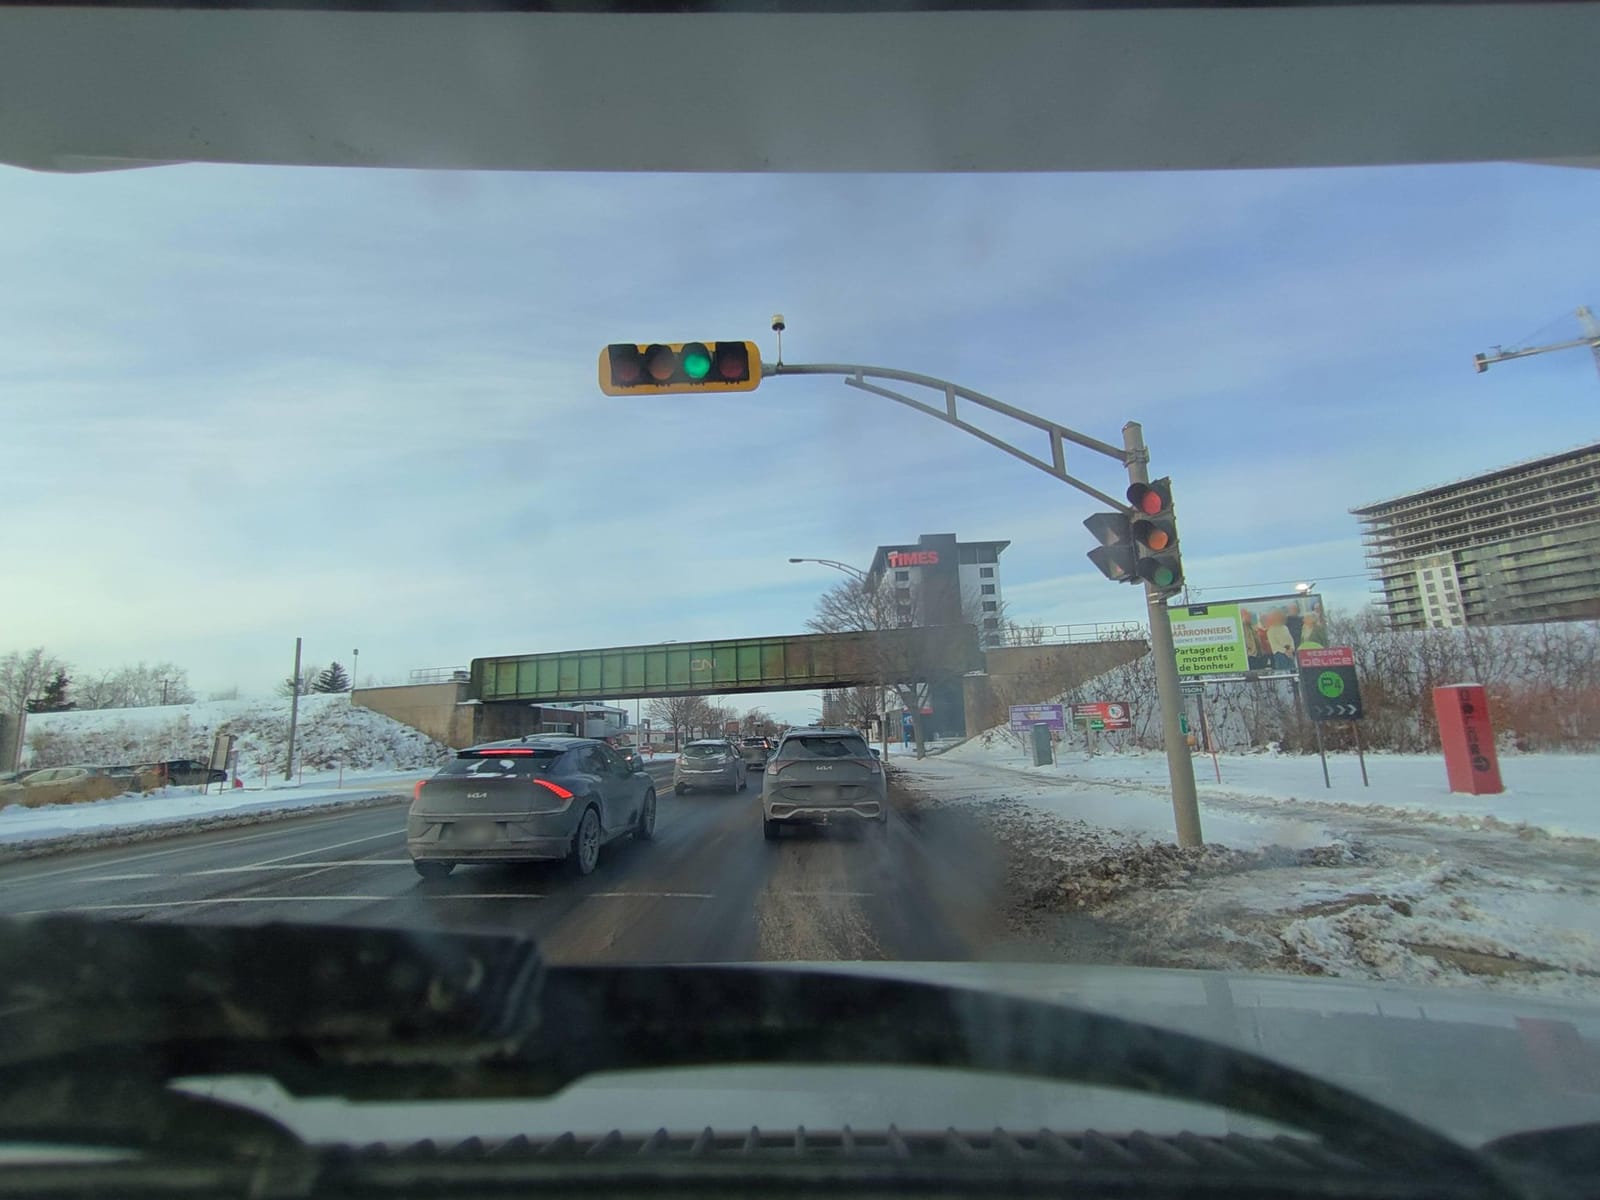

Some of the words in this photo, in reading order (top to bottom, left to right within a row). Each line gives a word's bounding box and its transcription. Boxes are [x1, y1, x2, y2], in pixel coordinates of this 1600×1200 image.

[888, 551, 938, 568] TIMES
[1175, 647, 1215, 655] Partager
[1183, 654, 1228, 663] moments
[691, 658, 716, 671] CN
[1179, 664, 1191, 672] de
[1194, 662, 1234, 671] bonheur
